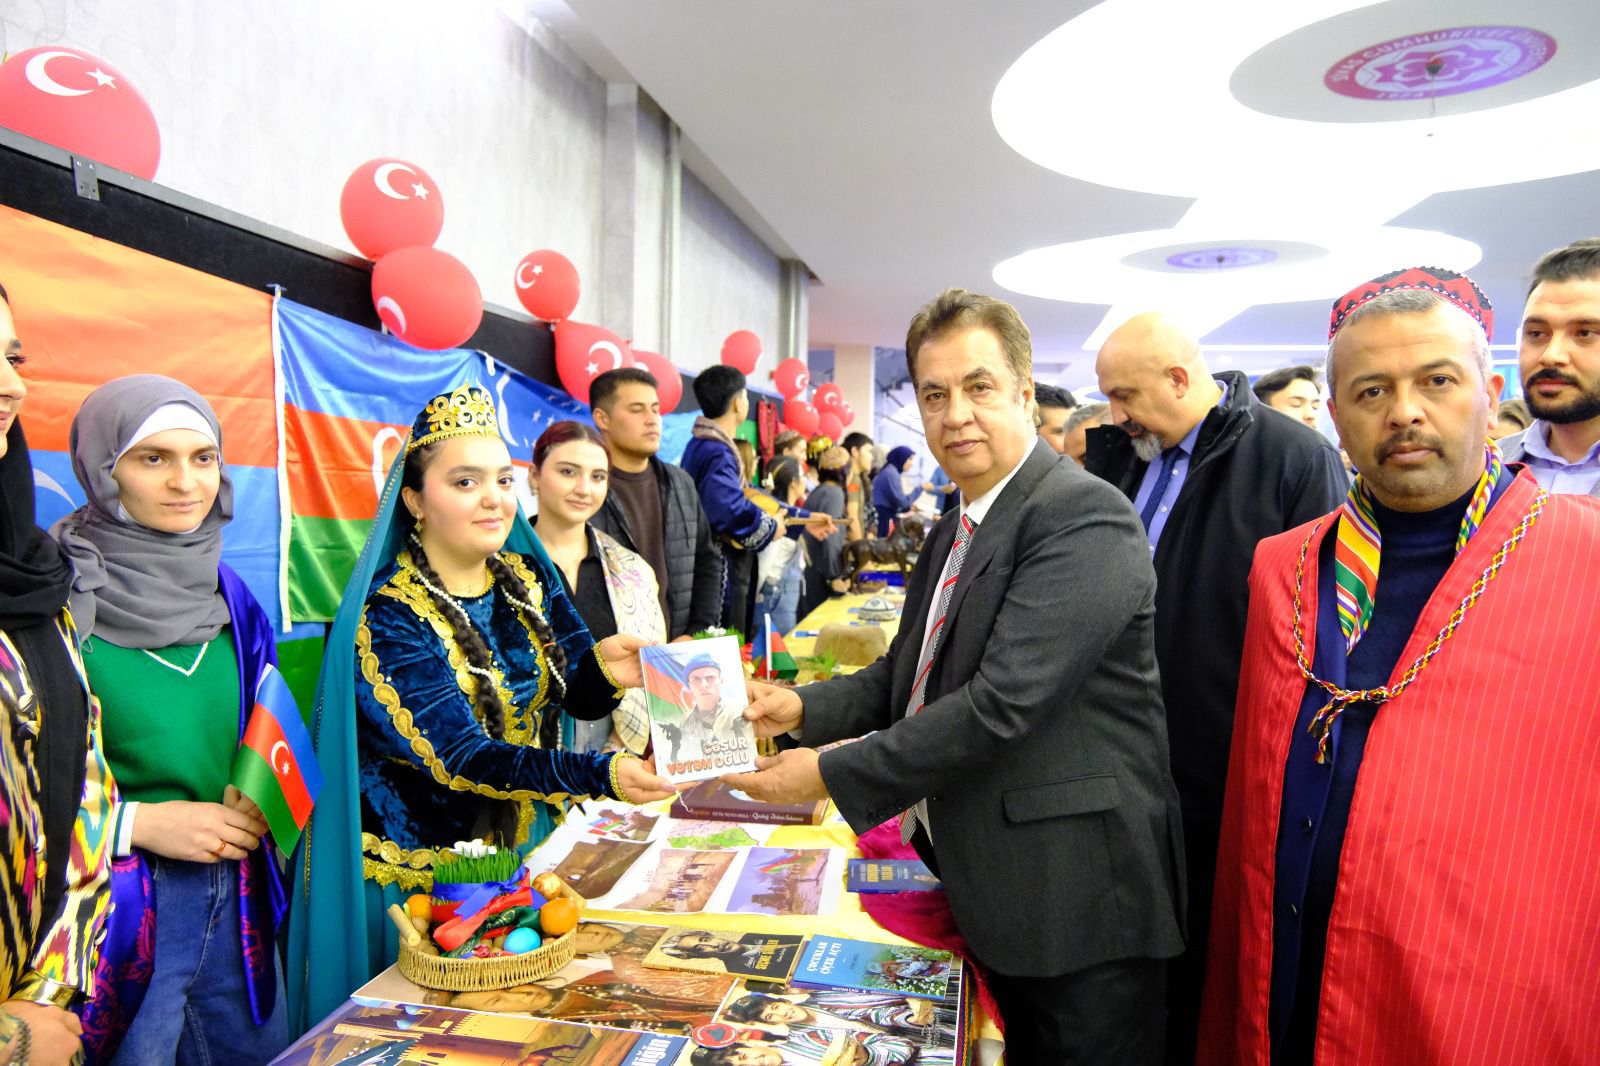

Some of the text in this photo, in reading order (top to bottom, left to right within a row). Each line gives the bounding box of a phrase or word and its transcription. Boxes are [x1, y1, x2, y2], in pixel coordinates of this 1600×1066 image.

[715, 750, 750, 768] OĞLU
[806, 941, 829, 972] ÇOCUKLAR
[820, 957, 836, 975] ÇİÇEK
